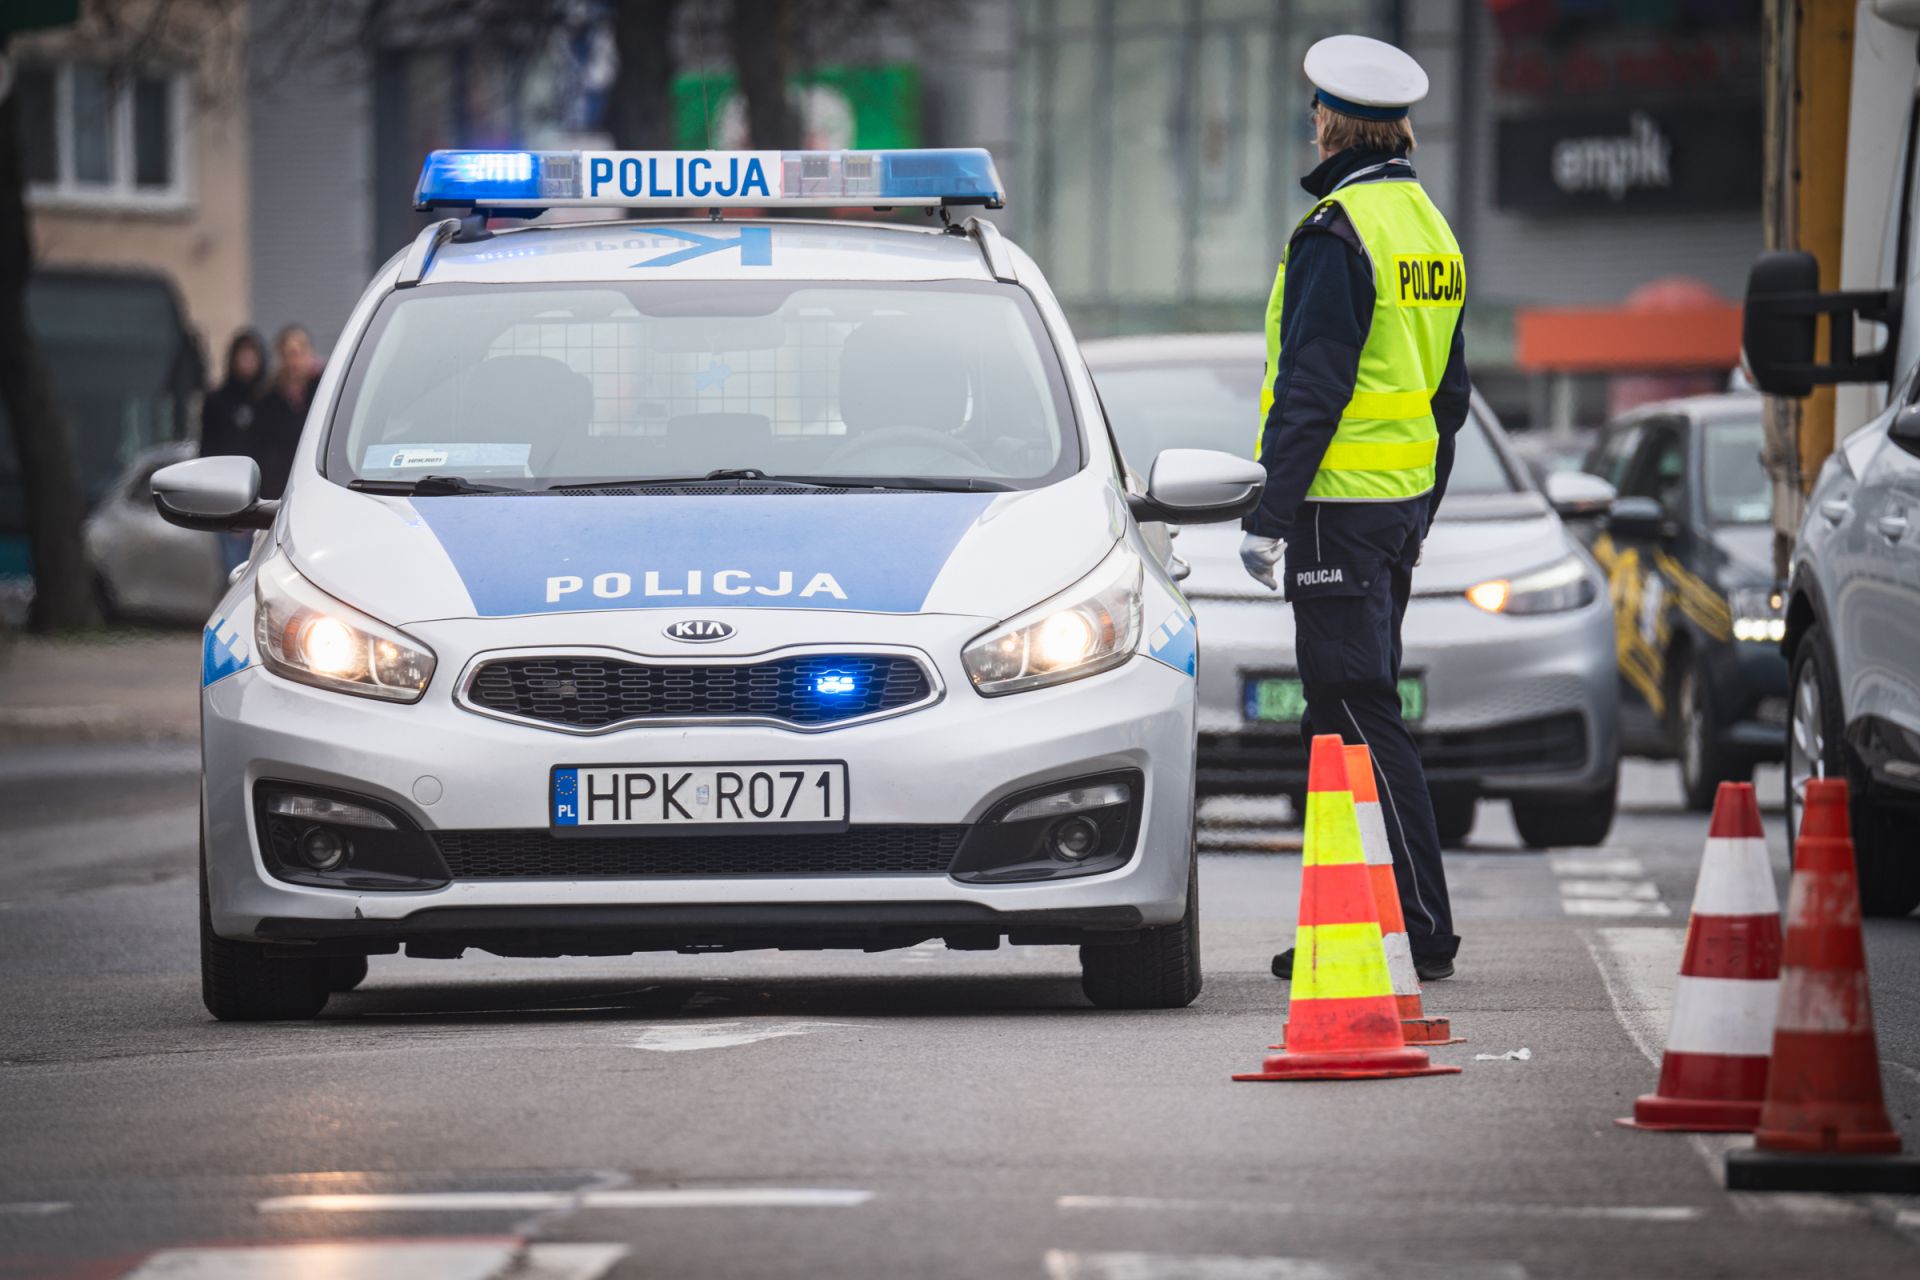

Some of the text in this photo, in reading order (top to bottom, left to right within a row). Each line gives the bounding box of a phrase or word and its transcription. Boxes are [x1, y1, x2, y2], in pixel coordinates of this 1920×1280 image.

[1554, 112, 1671, 199] empik
[590, 157, 770, 197] POLICJA
[1398, 260, 1462, 301] POLICJA
[546, 569, 848, 603] POLICJA
[1297, 568, 1343, 587] POLICJA
[675, 621, 725, 636] KIA
[558, 771, 830, 820] PL HPK R071
